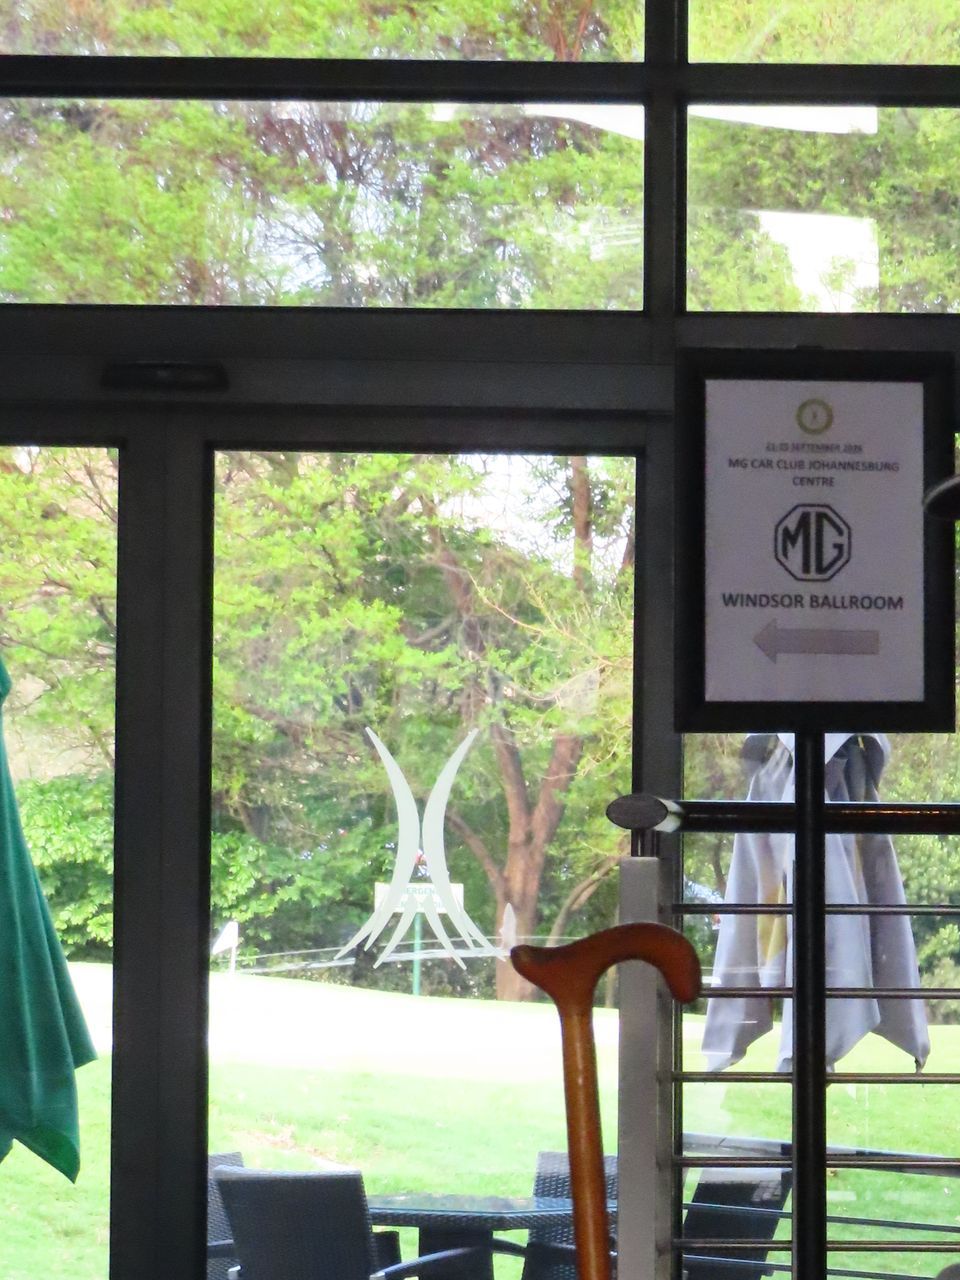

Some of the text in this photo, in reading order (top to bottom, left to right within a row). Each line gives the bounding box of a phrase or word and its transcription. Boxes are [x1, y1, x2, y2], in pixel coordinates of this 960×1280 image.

[791, 443, 841, 452] SEPTEMBER
[728, 458, 900, 472] MG CAR CLUB JOHANNESBURG
[791, 476, 836, 487] CENTRE
[781, 510, 845, 576] MG
[721, 592, 904, 610] WINDSOR BALLROOM
